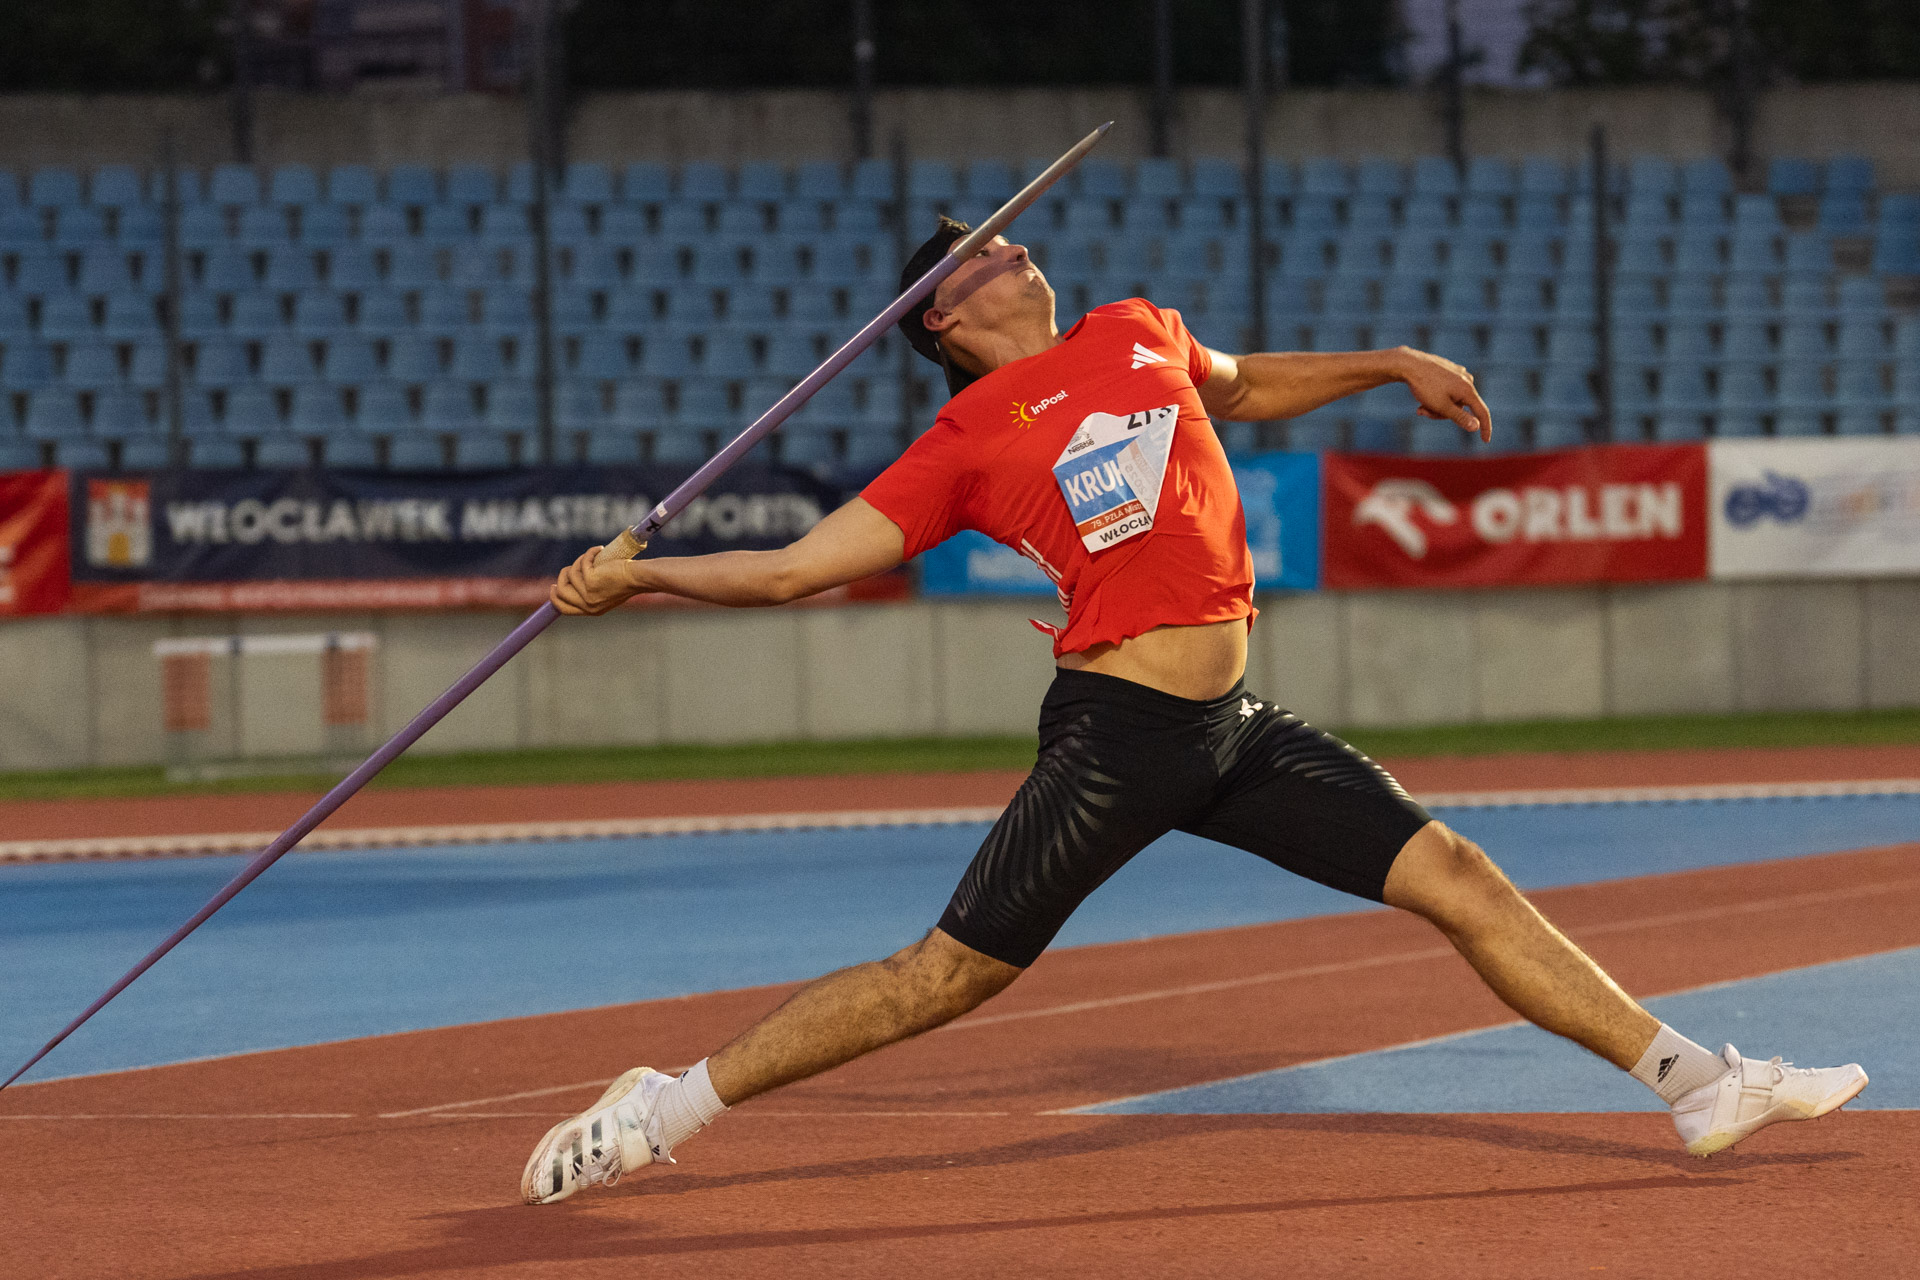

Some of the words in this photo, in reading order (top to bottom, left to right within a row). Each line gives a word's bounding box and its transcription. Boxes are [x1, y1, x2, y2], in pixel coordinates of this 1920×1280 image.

[1030, 389, 1069, 415] InPost
[1104, 510, 1124, 523] PZLA
[1471, 482, 1684, 543] ORLEN
